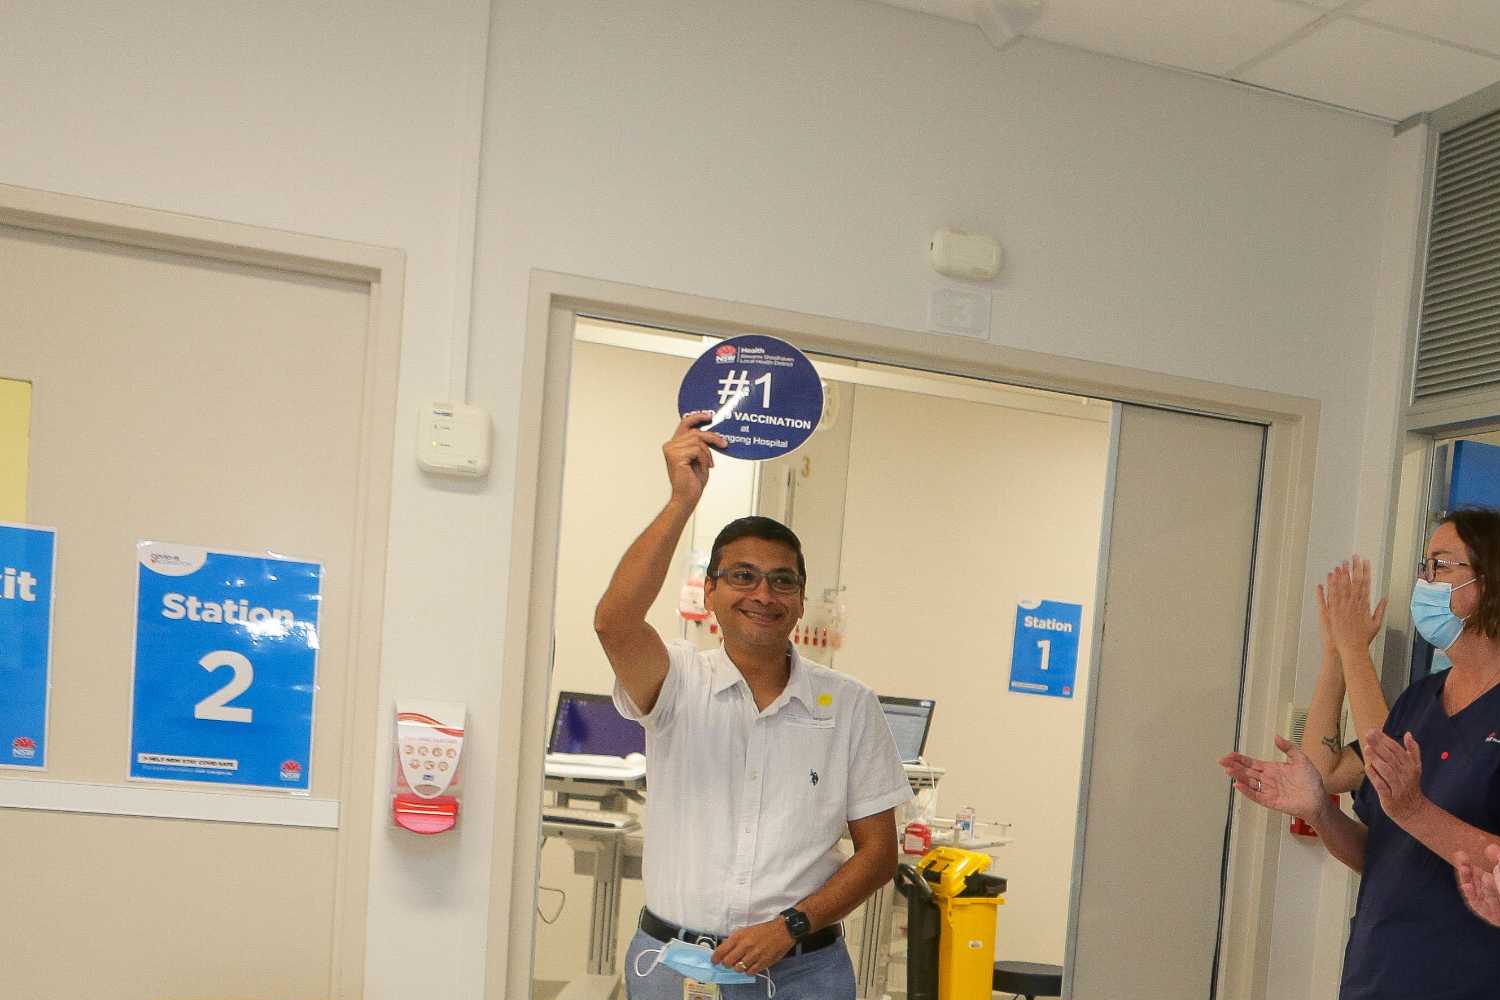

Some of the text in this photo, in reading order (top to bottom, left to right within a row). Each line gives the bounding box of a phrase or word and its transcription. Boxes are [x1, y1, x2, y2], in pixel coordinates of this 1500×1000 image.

[718, 370, 773, 409] #1
[734, 412, 812, 430] VACCINATION
[741, 425, 750, 433] at
[753, 436, 789, 448] Hospital
[0, 567, 37, 602] it
[161, 592, 295, 629] Station
[1023, 615, 1073, 633] Station
[1037, 640, 1051, 671] 1
[194, 649, 255, 723] 2
